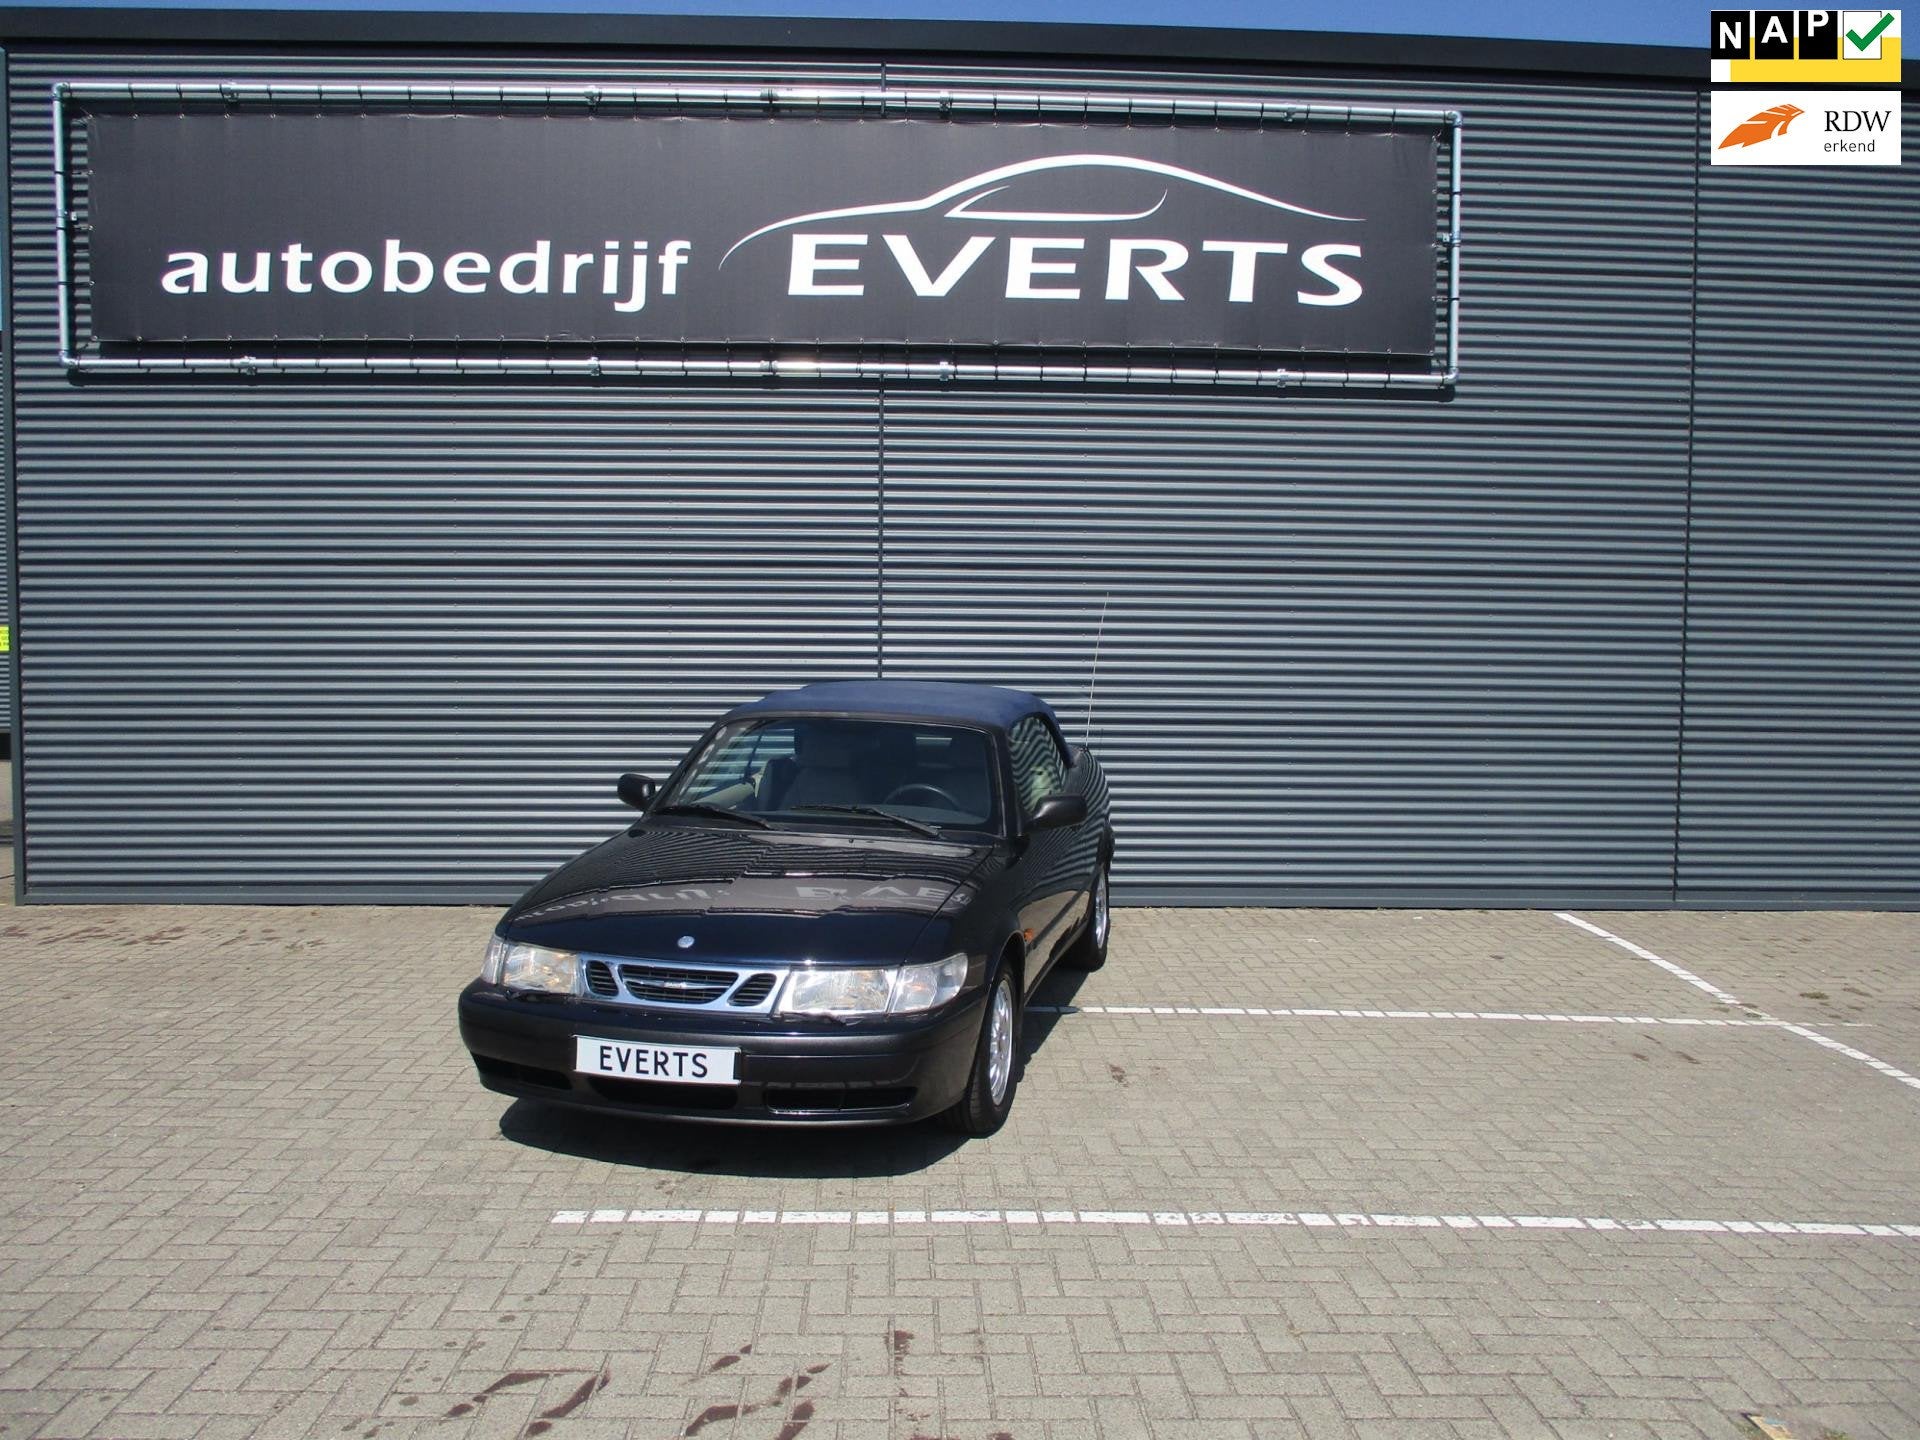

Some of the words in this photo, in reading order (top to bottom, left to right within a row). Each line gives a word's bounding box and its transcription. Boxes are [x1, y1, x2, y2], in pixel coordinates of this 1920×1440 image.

[160, 239, 692, 313] autobedrijf
[788, 234, 1363, 306] EVERTS
[600, 1045, 708, 1078] EVERTS
